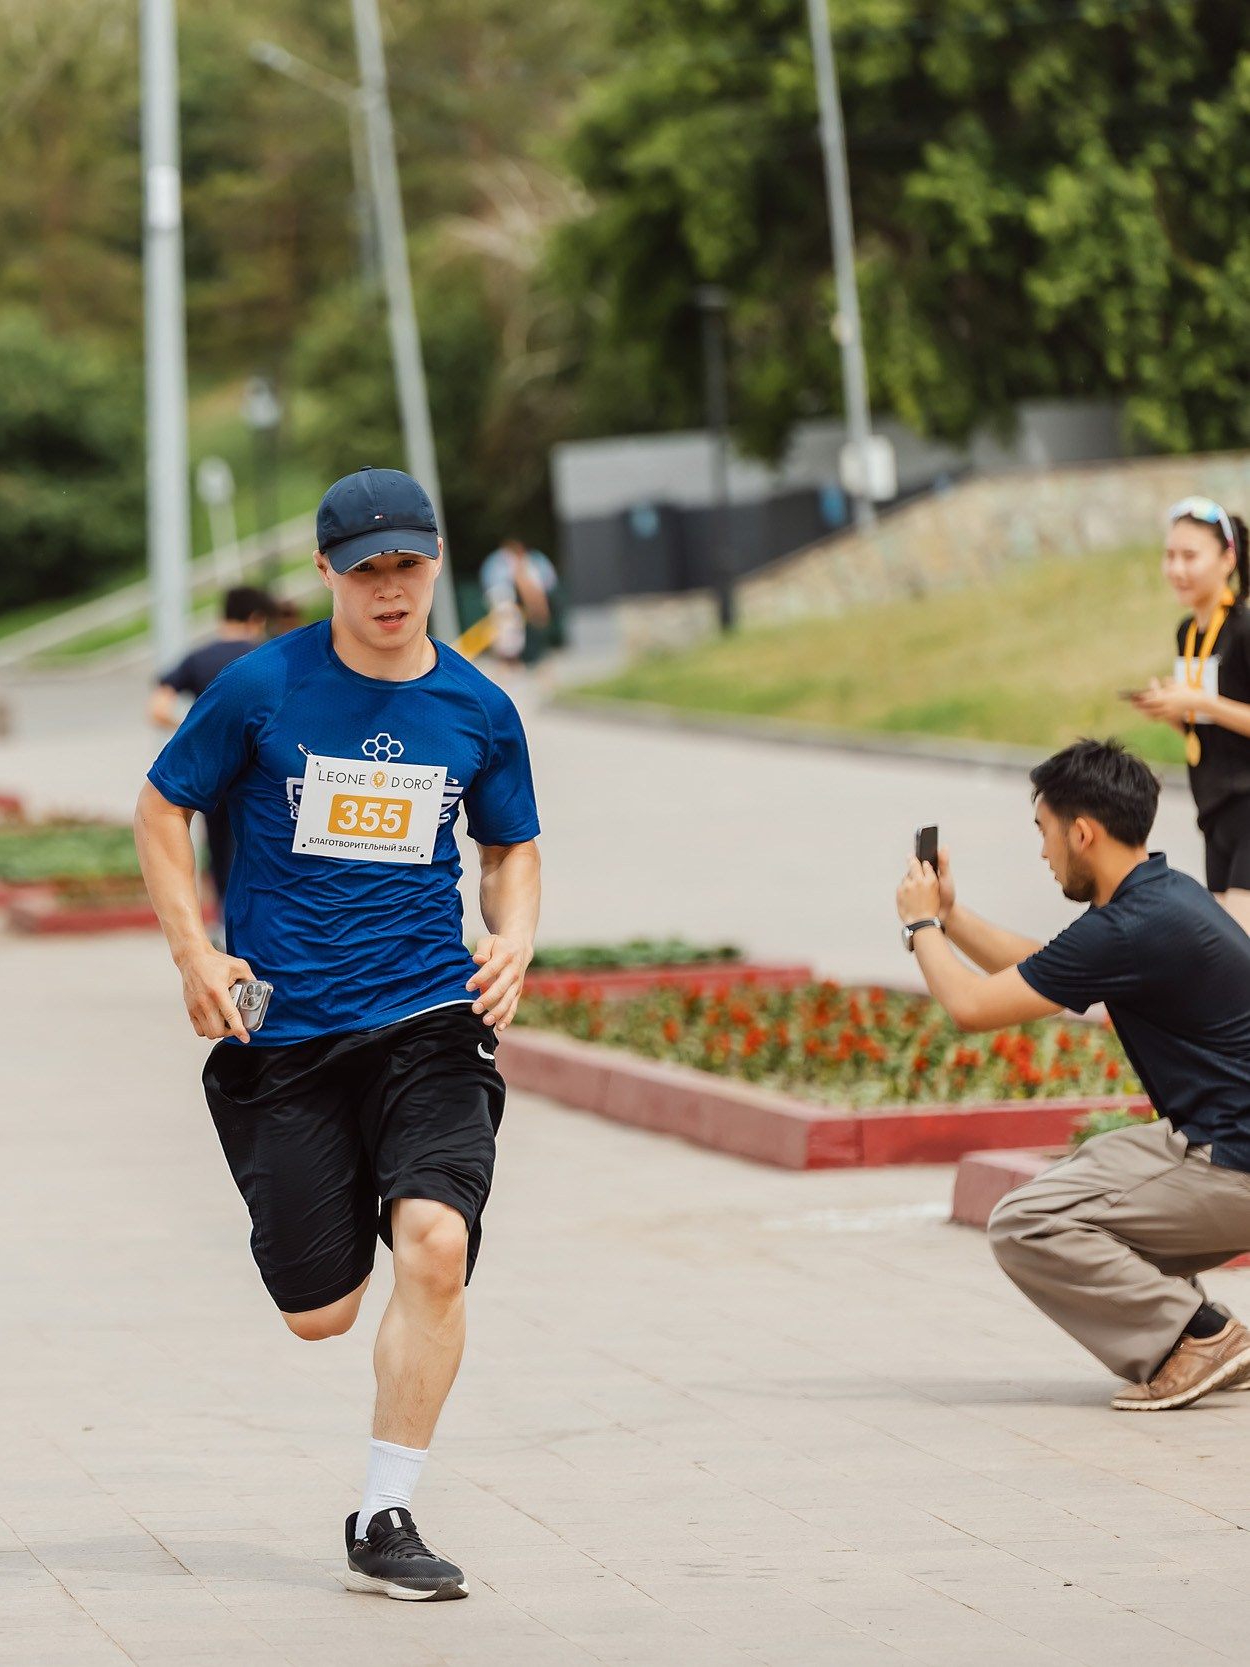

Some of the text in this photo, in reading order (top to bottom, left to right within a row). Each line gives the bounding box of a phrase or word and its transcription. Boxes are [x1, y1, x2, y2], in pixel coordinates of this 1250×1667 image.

[318, 770, 433, 790] LEONE D'ORO
[337, 800, 403, 834] 355
[308, 837, 420, 853] БЛАГОТВОРИТЕЛЬНЫЙ ЗАБЕГ
